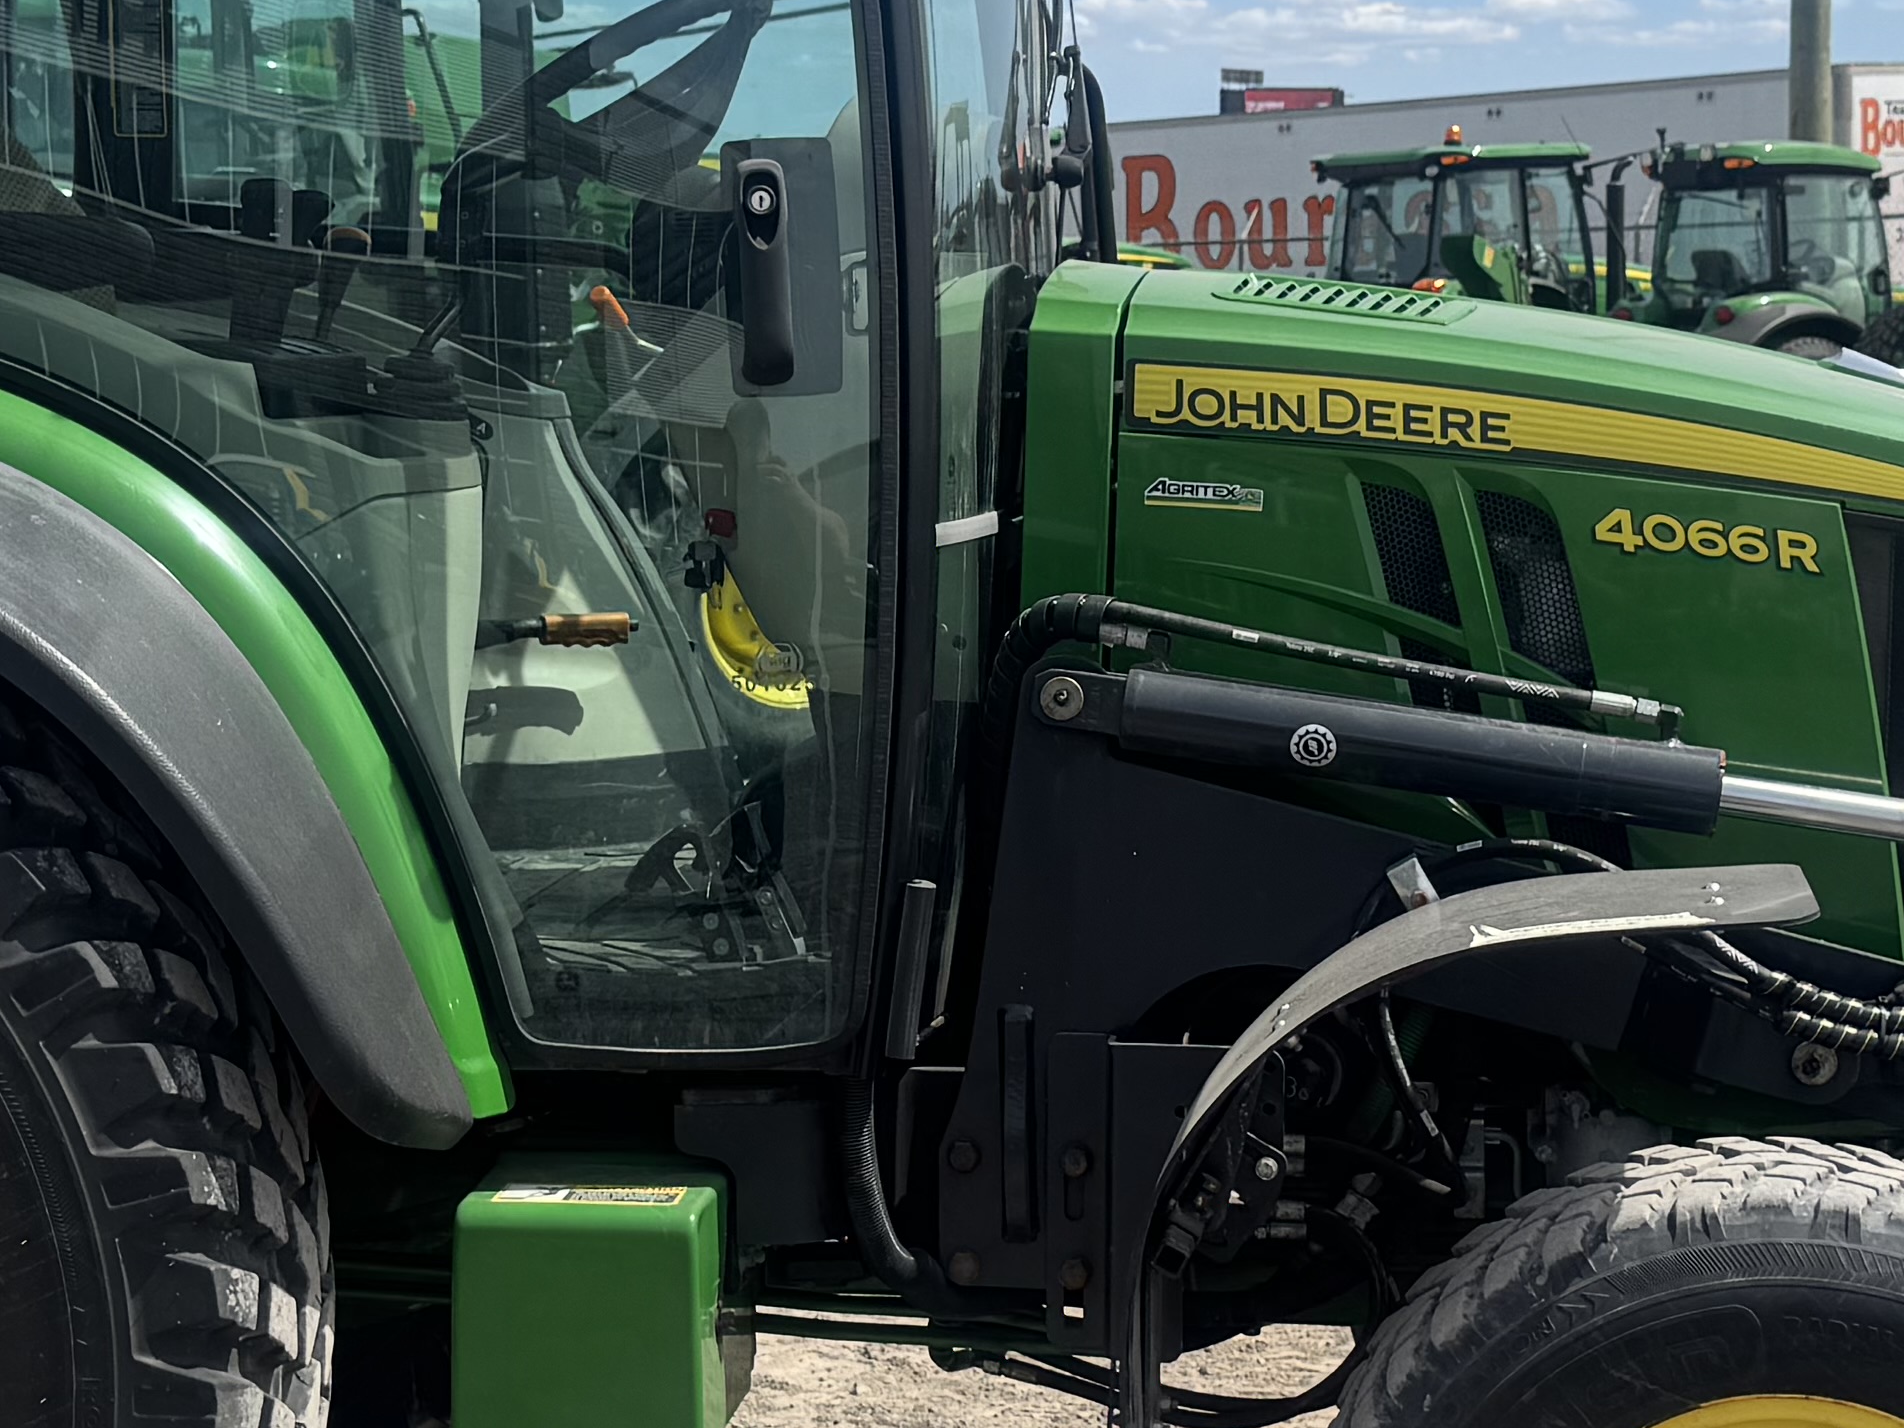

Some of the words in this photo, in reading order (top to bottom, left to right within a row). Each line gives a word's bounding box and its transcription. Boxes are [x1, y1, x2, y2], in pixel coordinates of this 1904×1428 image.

[1154, 378, 1307, 428] JOHN
[1318, 387, 1512, 446] DEERE
[1149, 477, 1240, 500] AGRITEX
